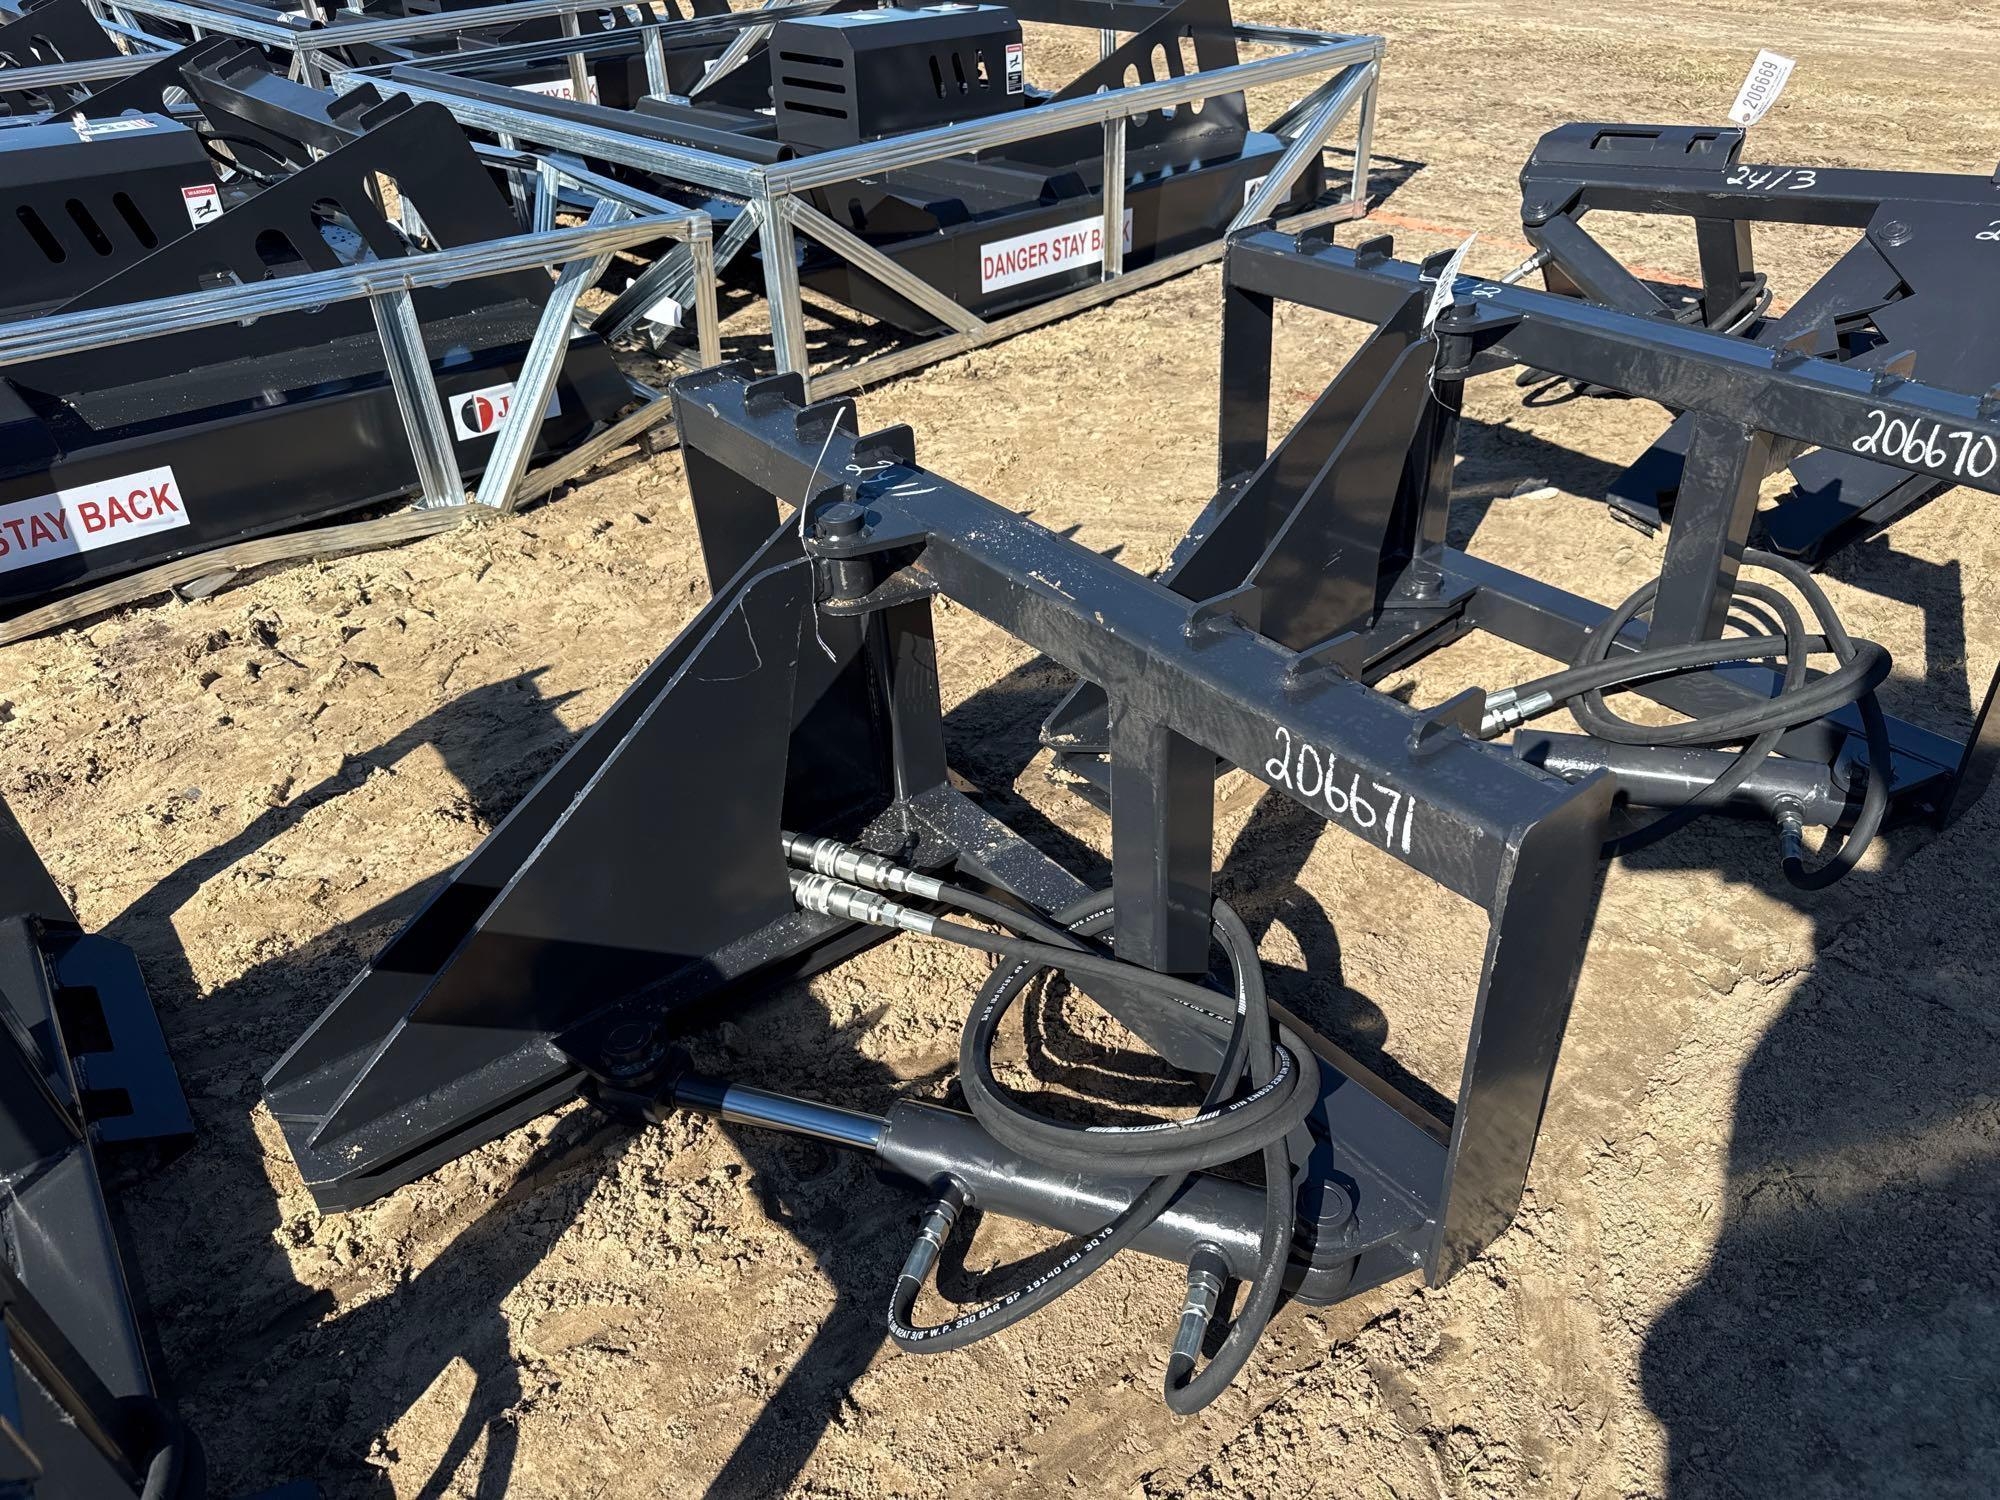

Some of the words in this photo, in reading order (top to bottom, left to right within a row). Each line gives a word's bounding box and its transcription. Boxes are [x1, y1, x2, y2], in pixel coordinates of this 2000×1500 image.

[1742, 61, 1778, 110] 206669
[984, 242, 1048, 281] DANGER
[1052, 231, 1088, 262] STAY
[1091, 220, 1130, 251] BK
[1852, 410, 1997, 477] 206670
[78, 483, 179, 534] BACK
[1265, 727, 1416, 854] 206671
[1229, 1100, 1248, 1110] DIN
[956, 1314, 976, 1330] 330
[979, 1303, 1001, 1320] BAR
[1005, 1291, 1022, 1305] BP
[1026, 1266, 1061, 1294] 19140
[1062, 1252, 1082, 1269] PSI
[1098, 1226, 1114, 1240] YS
